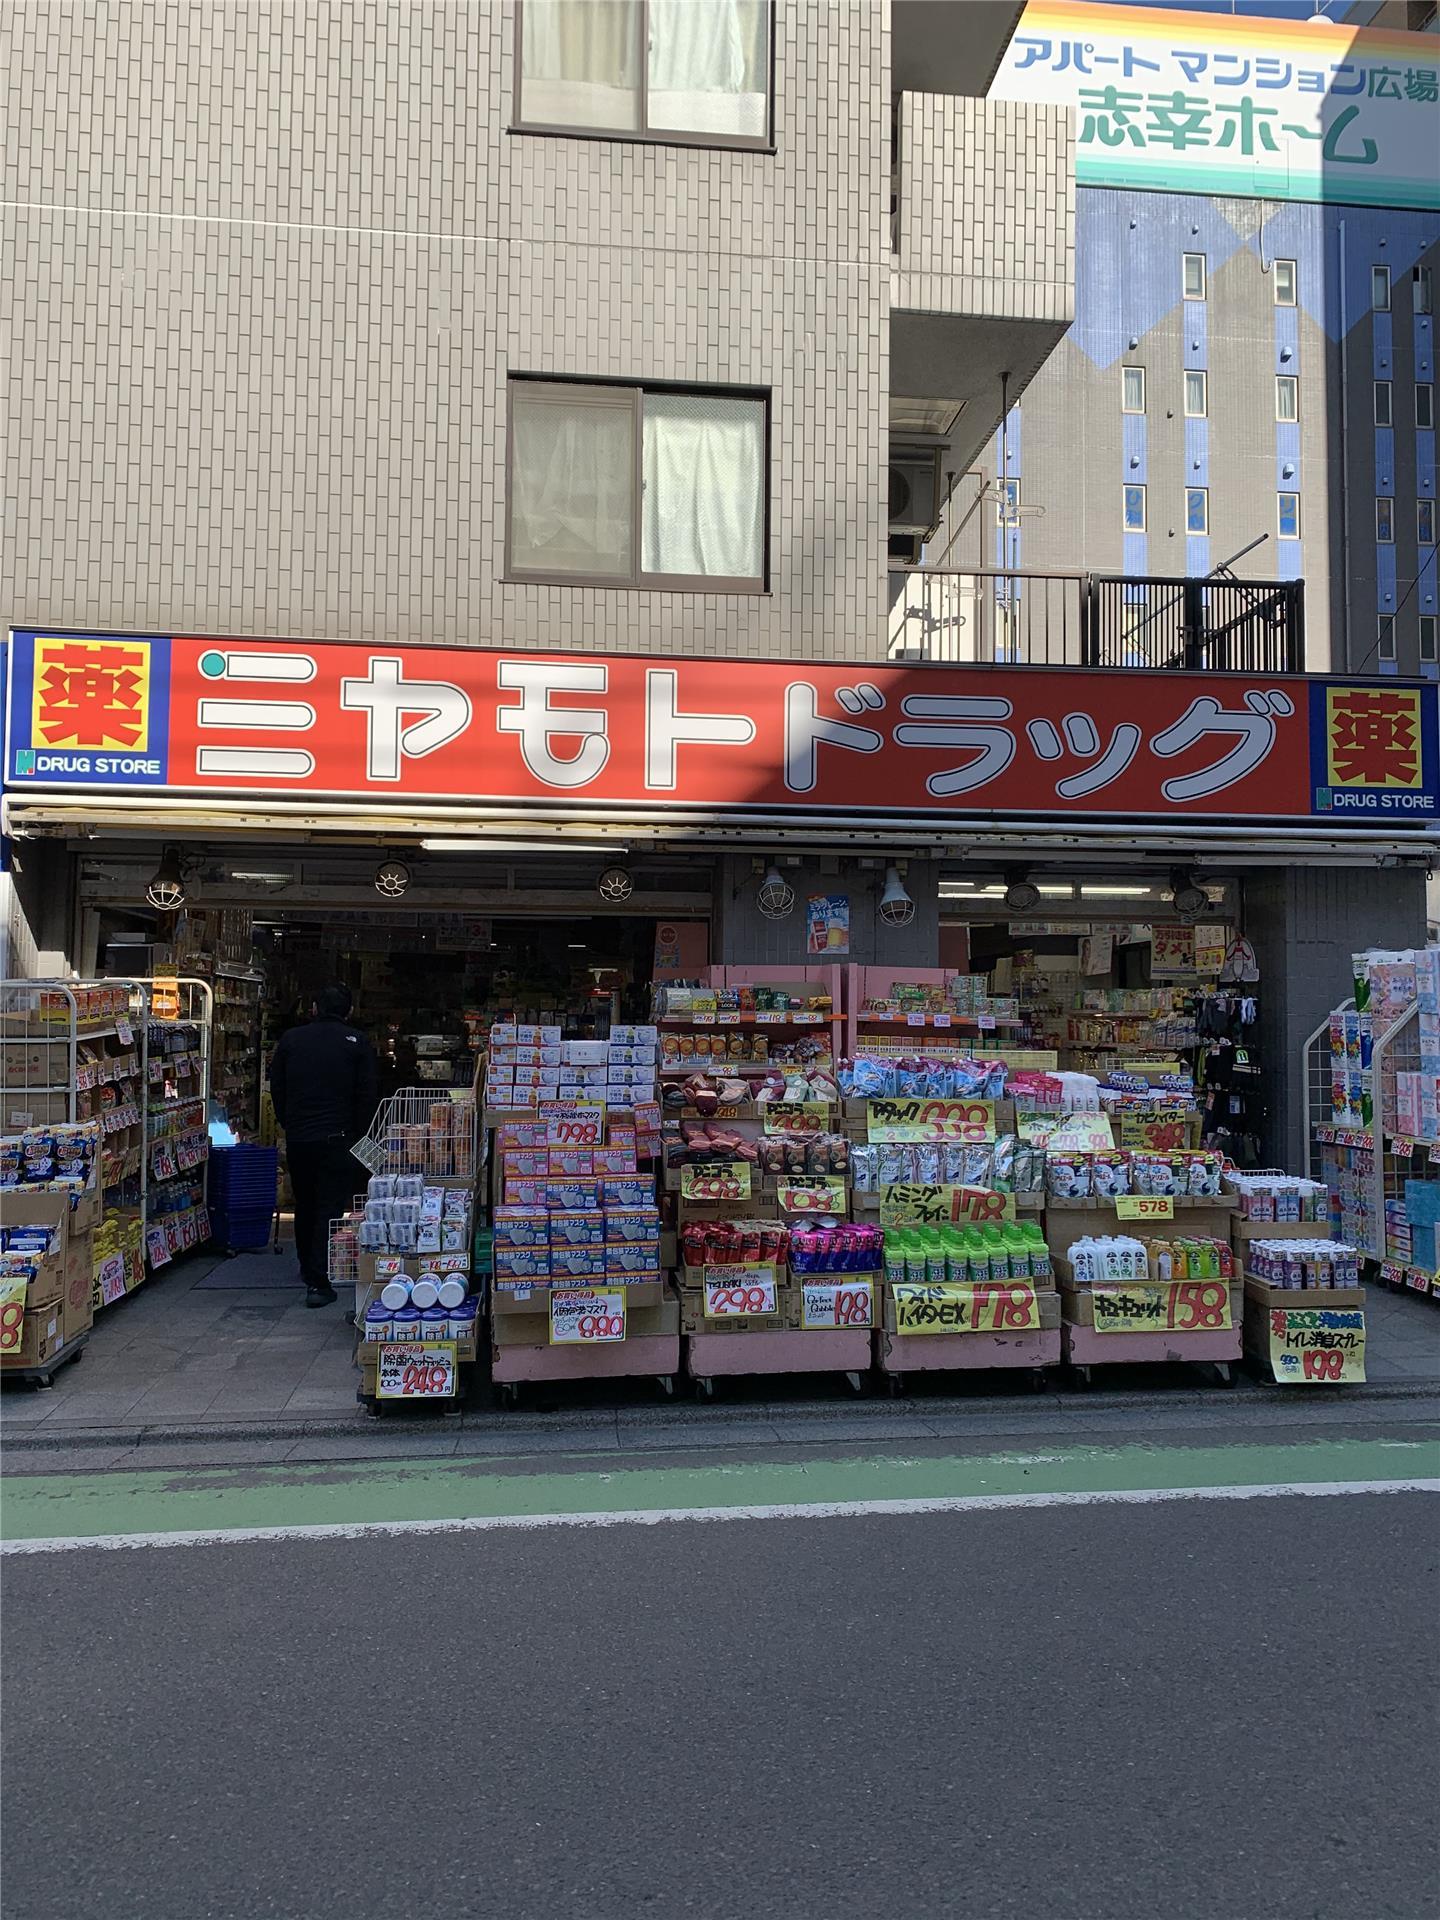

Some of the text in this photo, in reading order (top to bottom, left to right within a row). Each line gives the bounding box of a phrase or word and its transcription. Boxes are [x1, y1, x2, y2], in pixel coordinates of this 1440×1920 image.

[1078, 85, 1378, 165] 志幸ホーム
[39, 643, 143, 747] 薬
[197, 650, 1294, 801] ミヤモトドラッグ
[1332, 691, 1417, 785] 薬
[37, 757, 161, 775] DRUG STORE
[1333, 793, 1435, 809] DRUG STORE
[557, 1123, 597, 1144] 798
[885, 1185, 943, 1203] ハミング
[952, 1189, 1007, 1222] 178
[1139, 1200, 1168, 1212] 578
[710, 1287, 765, 1313] 298
[835, 1291, 869, 1325] 198
[971, 1282, 1034, 1328] 178
[1095, 1294, 1168, 1318] キュキュット
[1167, 1282, 1228, 1329] 158
[578, 1316, 624, 1338] 880
[1287, 1331, 1365, 1348] トイレ消臭スプレー
[402, 1365, 447, 1394] 248
[1303, 1350, 1344, 1380] 198
